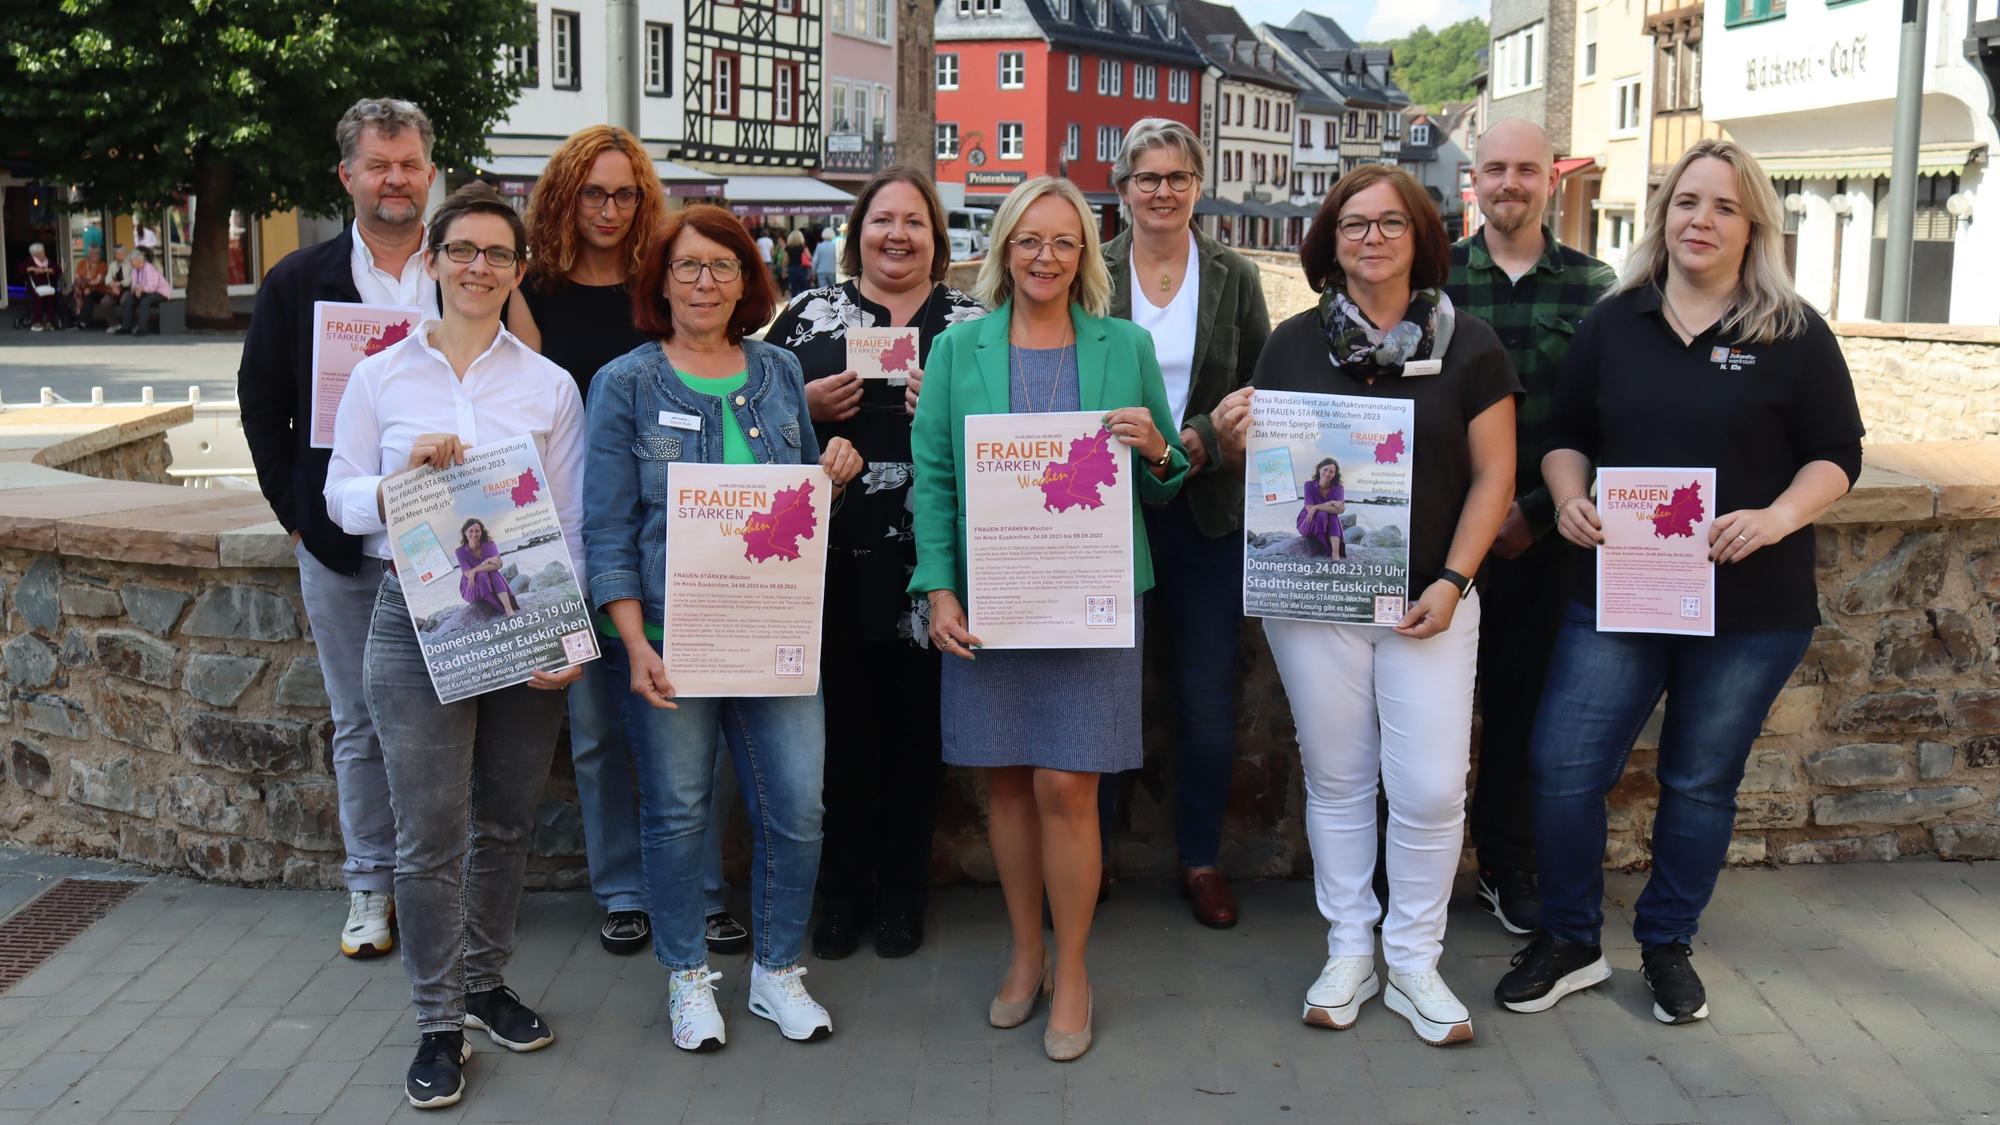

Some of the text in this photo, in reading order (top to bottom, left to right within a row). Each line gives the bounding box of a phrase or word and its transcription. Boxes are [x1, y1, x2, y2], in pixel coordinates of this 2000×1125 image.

[1746, 55, 1812, 91] Bäckerei
[1830, 33, 1867, 78] Café
[969, 173, 1021, 183] Printenhaus
[327, 320, 380, 335] FRAUEN
[849, 338, 891, 347] FRAUEN
[1253, 407, 1264, 415] der
[1254, 395, 1272, 404] Tessa
[1274, 397, 1301, 405] Randau
[1303, 398, 1317, 406] liest
[1332, 400, 1407, 413] Auftaktveranstaltung
[1266, 419, 1287, 427] ihrem
[1289, 420, 1351, 431] Spiegel-Bestseller
[1351, 432, 1385, 442] FRAUEN
[976, 440, 1063, 459] FRAUEN
[976, 458, 1041, 473] STÄRKEN
[389, 496, 399, 504] der
[488, 459, 506, 470] 2023
[483, 477, 518, 493] FRAUEN
[1017, 467, 1068, 489] Wochen
[388, 482, 403, 493] Tessa
[401, 498, 419, 510] ihrem
[420, 479, 481, 503] Spiegel-Bestseller
[1608, 489, 1668, 501] FRAUEN
[679, 489, 767, 508] FRAUEN
[1608, 500, 1652, 510] STÄRKEN
[406, 508, 423, 519] Meer
[424, 503, 439, 513] und
[678, 506, 744, 520] STÄRKEN
[719, 517, 770, 537] Wochen
[1247, 558, 1405, 577] Donnerstag, 24.08.23, 19 Uhr
[1247, 576, 1404, 594] Stadttheater Euskirchen
[1247, 591, 1277, 599] Programm
[1259, 600, 1279, 608] Karten
[1300, 603, 1322, 612] Lesung
[1323, 604, 1335, 613] gibt
[1345, 605, 1358, 613] hier:
[425, 600, 583, 656] Donnerstag, 24.08.23, 19 Uhr
[430, 617, 588, 674] Stadttheater Euskirchen
[435, 670, 467, 684] Programm
[468, 665, 477, 674] der
[439, 683, 450, 692] und
[451, 679, 471, 688] Karten
[472, 674, 481, 682] für
[482, 672, 491, 680] die
[492, 665, 514, 677] Lesung
[515, 661, 527, 671] gibt
[535, 654, 550, 662] hier:
